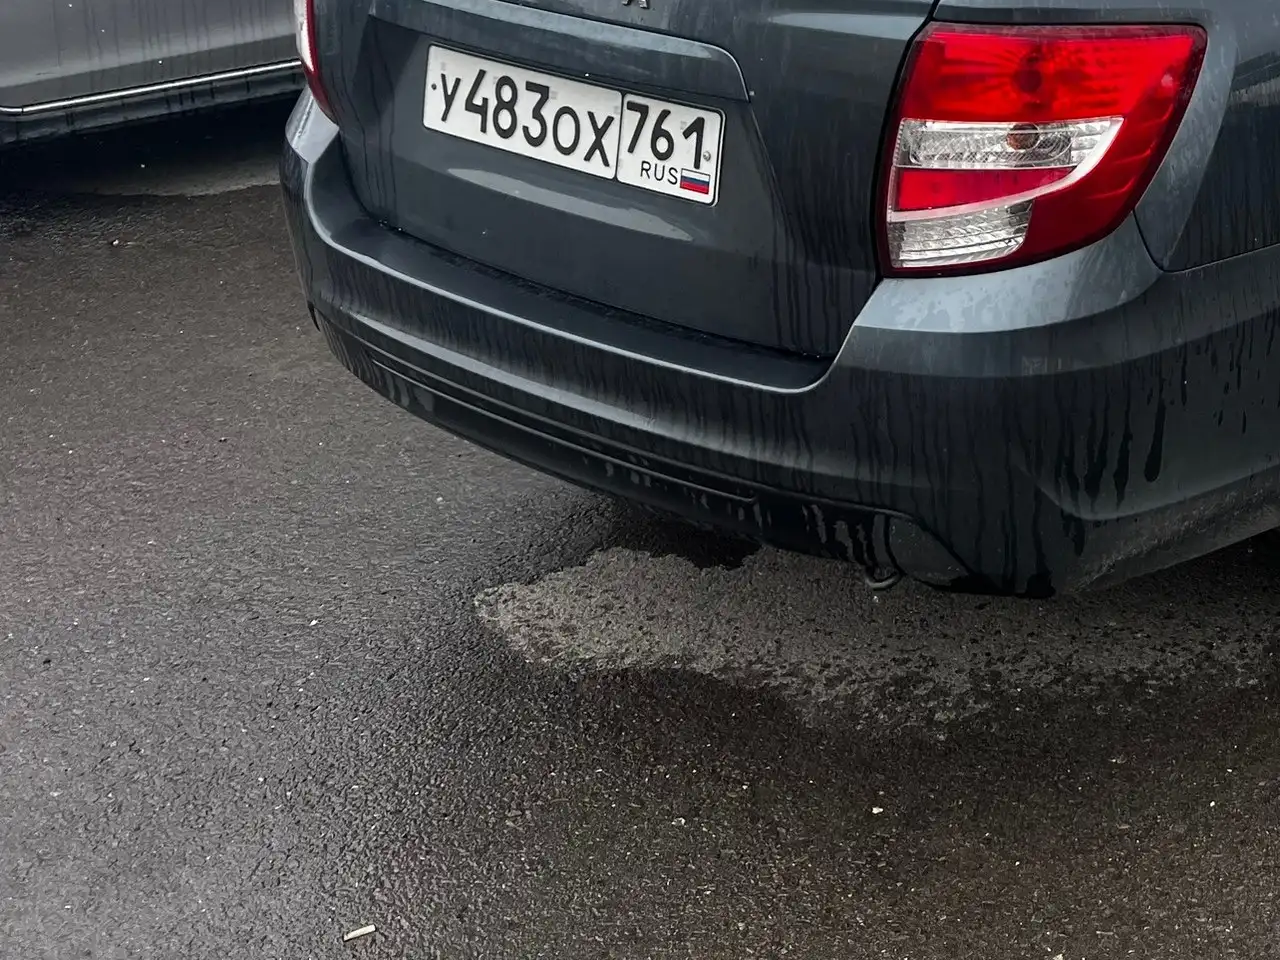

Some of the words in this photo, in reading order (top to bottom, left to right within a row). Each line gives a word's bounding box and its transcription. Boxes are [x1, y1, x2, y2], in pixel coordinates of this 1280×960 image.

[440, 69, 615, 168] У483ОХ
[626, 101, 705, 170] 761
[640, 161, 679, 186] RUS
